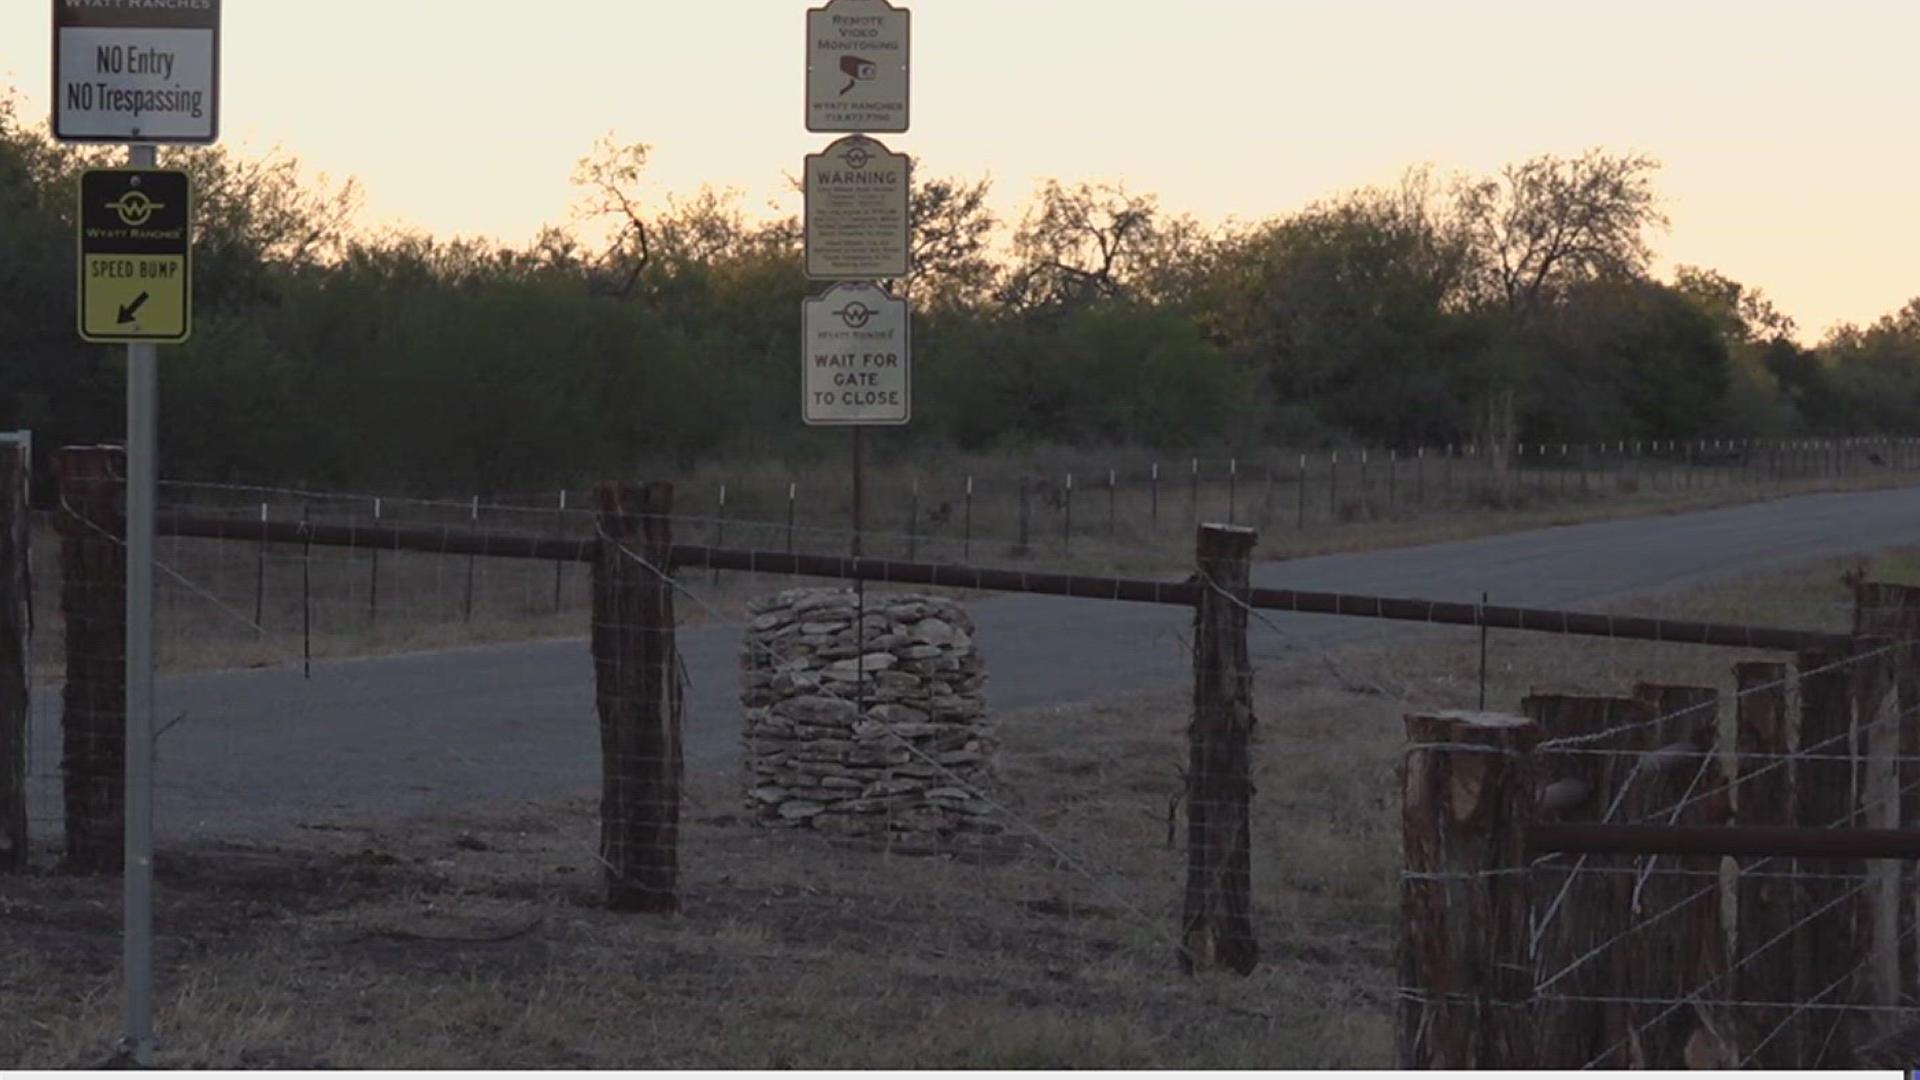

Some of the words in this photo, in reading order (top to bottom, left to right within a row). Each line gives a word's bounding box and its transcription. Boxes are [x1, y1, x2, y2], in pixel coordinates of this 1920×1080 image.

[832, 15, 884, 25] REMOTE
[839, 28, 879, 38] VIDEO
[818, 39, 899, 50] MONITORING
[97, 46, 122, 74] NO
[128, 46, 175, 80] Entry
[68, 83, 92, 111] NO
[96, 83, 203, 117] Trespassing
[817, 171, 897, 184] WARNING
[86, 228, 127, 239] WYATT
[92, 260, 134, 278] SPEED
[140, 260, 178, 279] BUMP
[814, 353, 855, 368] WAIT
[863, 353, 898, 368] FOR
[833, 372, 879, 386] GATE
[814, 391, 835, 405] TO
[842, 391, 899, 406] CLOSE
